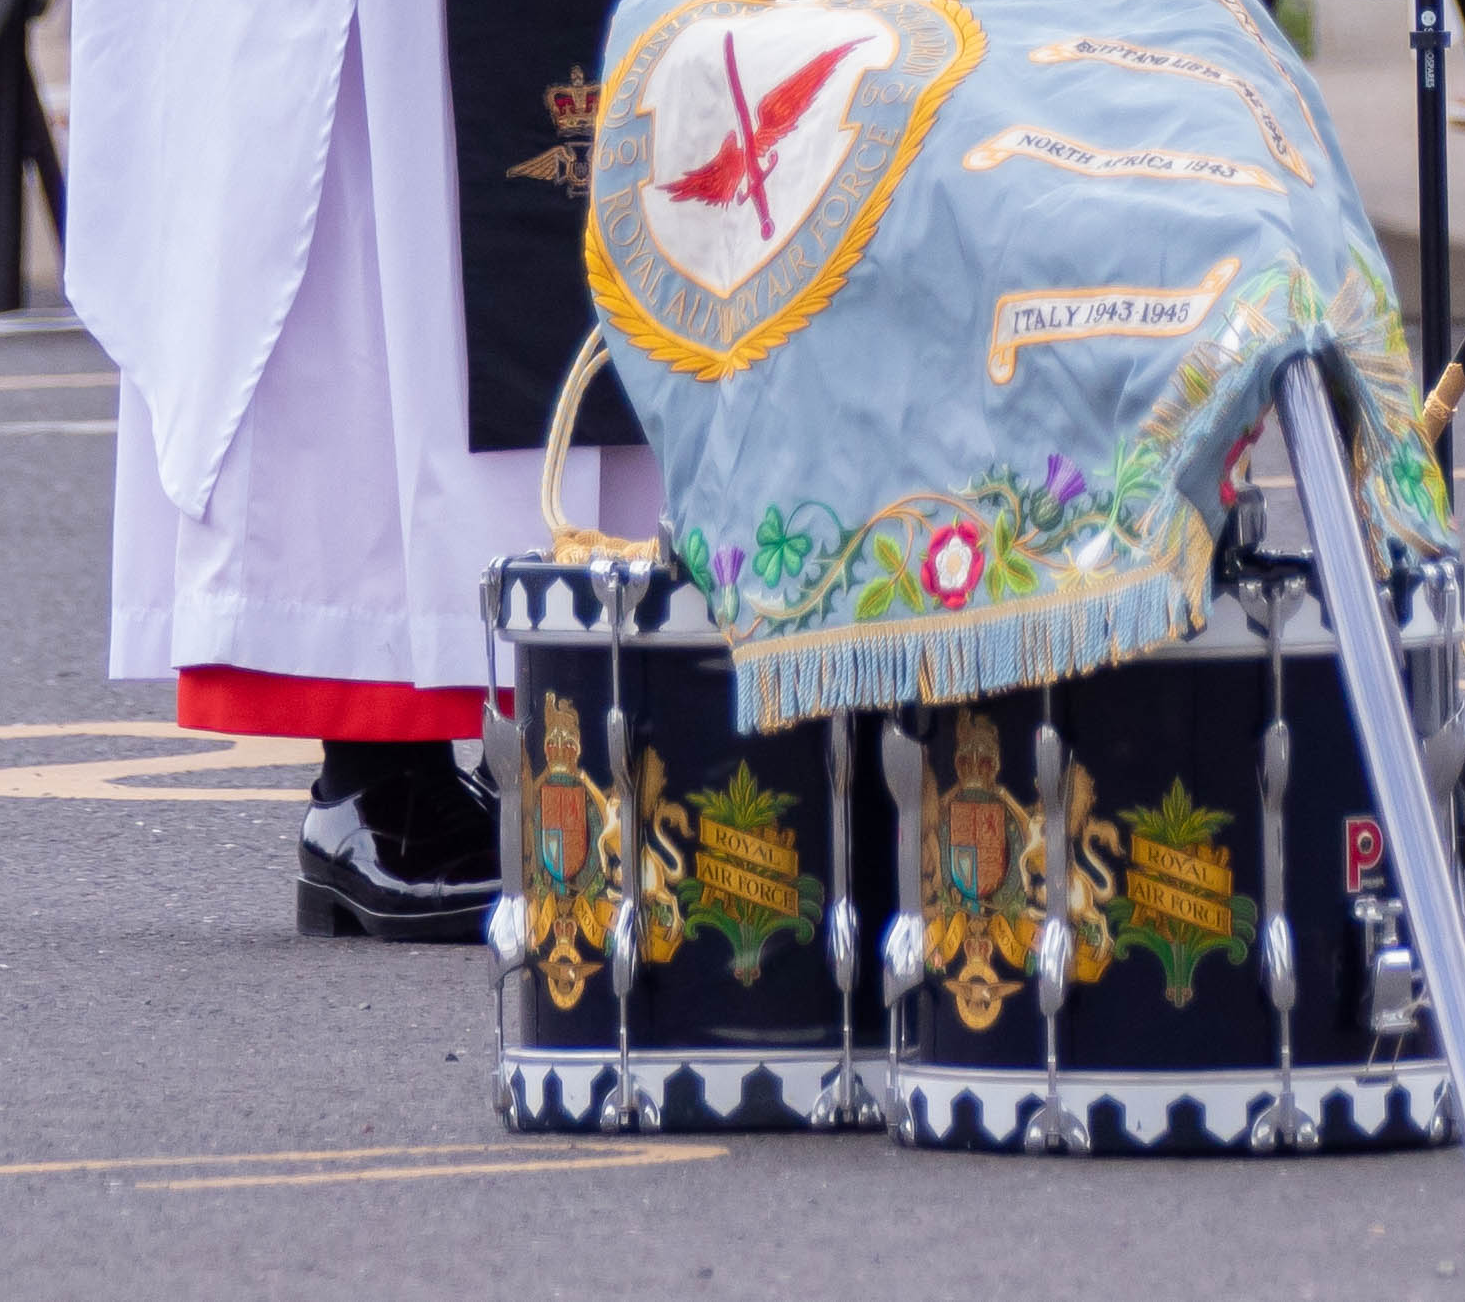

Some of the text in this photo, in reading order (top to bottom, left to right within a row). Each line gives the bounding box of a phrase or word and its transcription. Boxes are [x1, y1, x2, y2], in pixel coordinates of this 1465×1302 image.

[862, 78, 916, 107] 601
[598, 134, 648, 172] 601
[1016, 134, 1096, 165] NORTH
[600, 186, 666, 305] ROYAL
[767, 244, 818, 303] AIR
[810, 122, 902, 250] FORCE
[1013, 304, 1081, 334] ITALY
[715, 827, 779, 864] ROYAL
[1148, 844, 1214, 885] ROYAL
[702, 861, 795, 910] AIR FORCE
[1135, 881, 1225, 930] AIR FORCE
